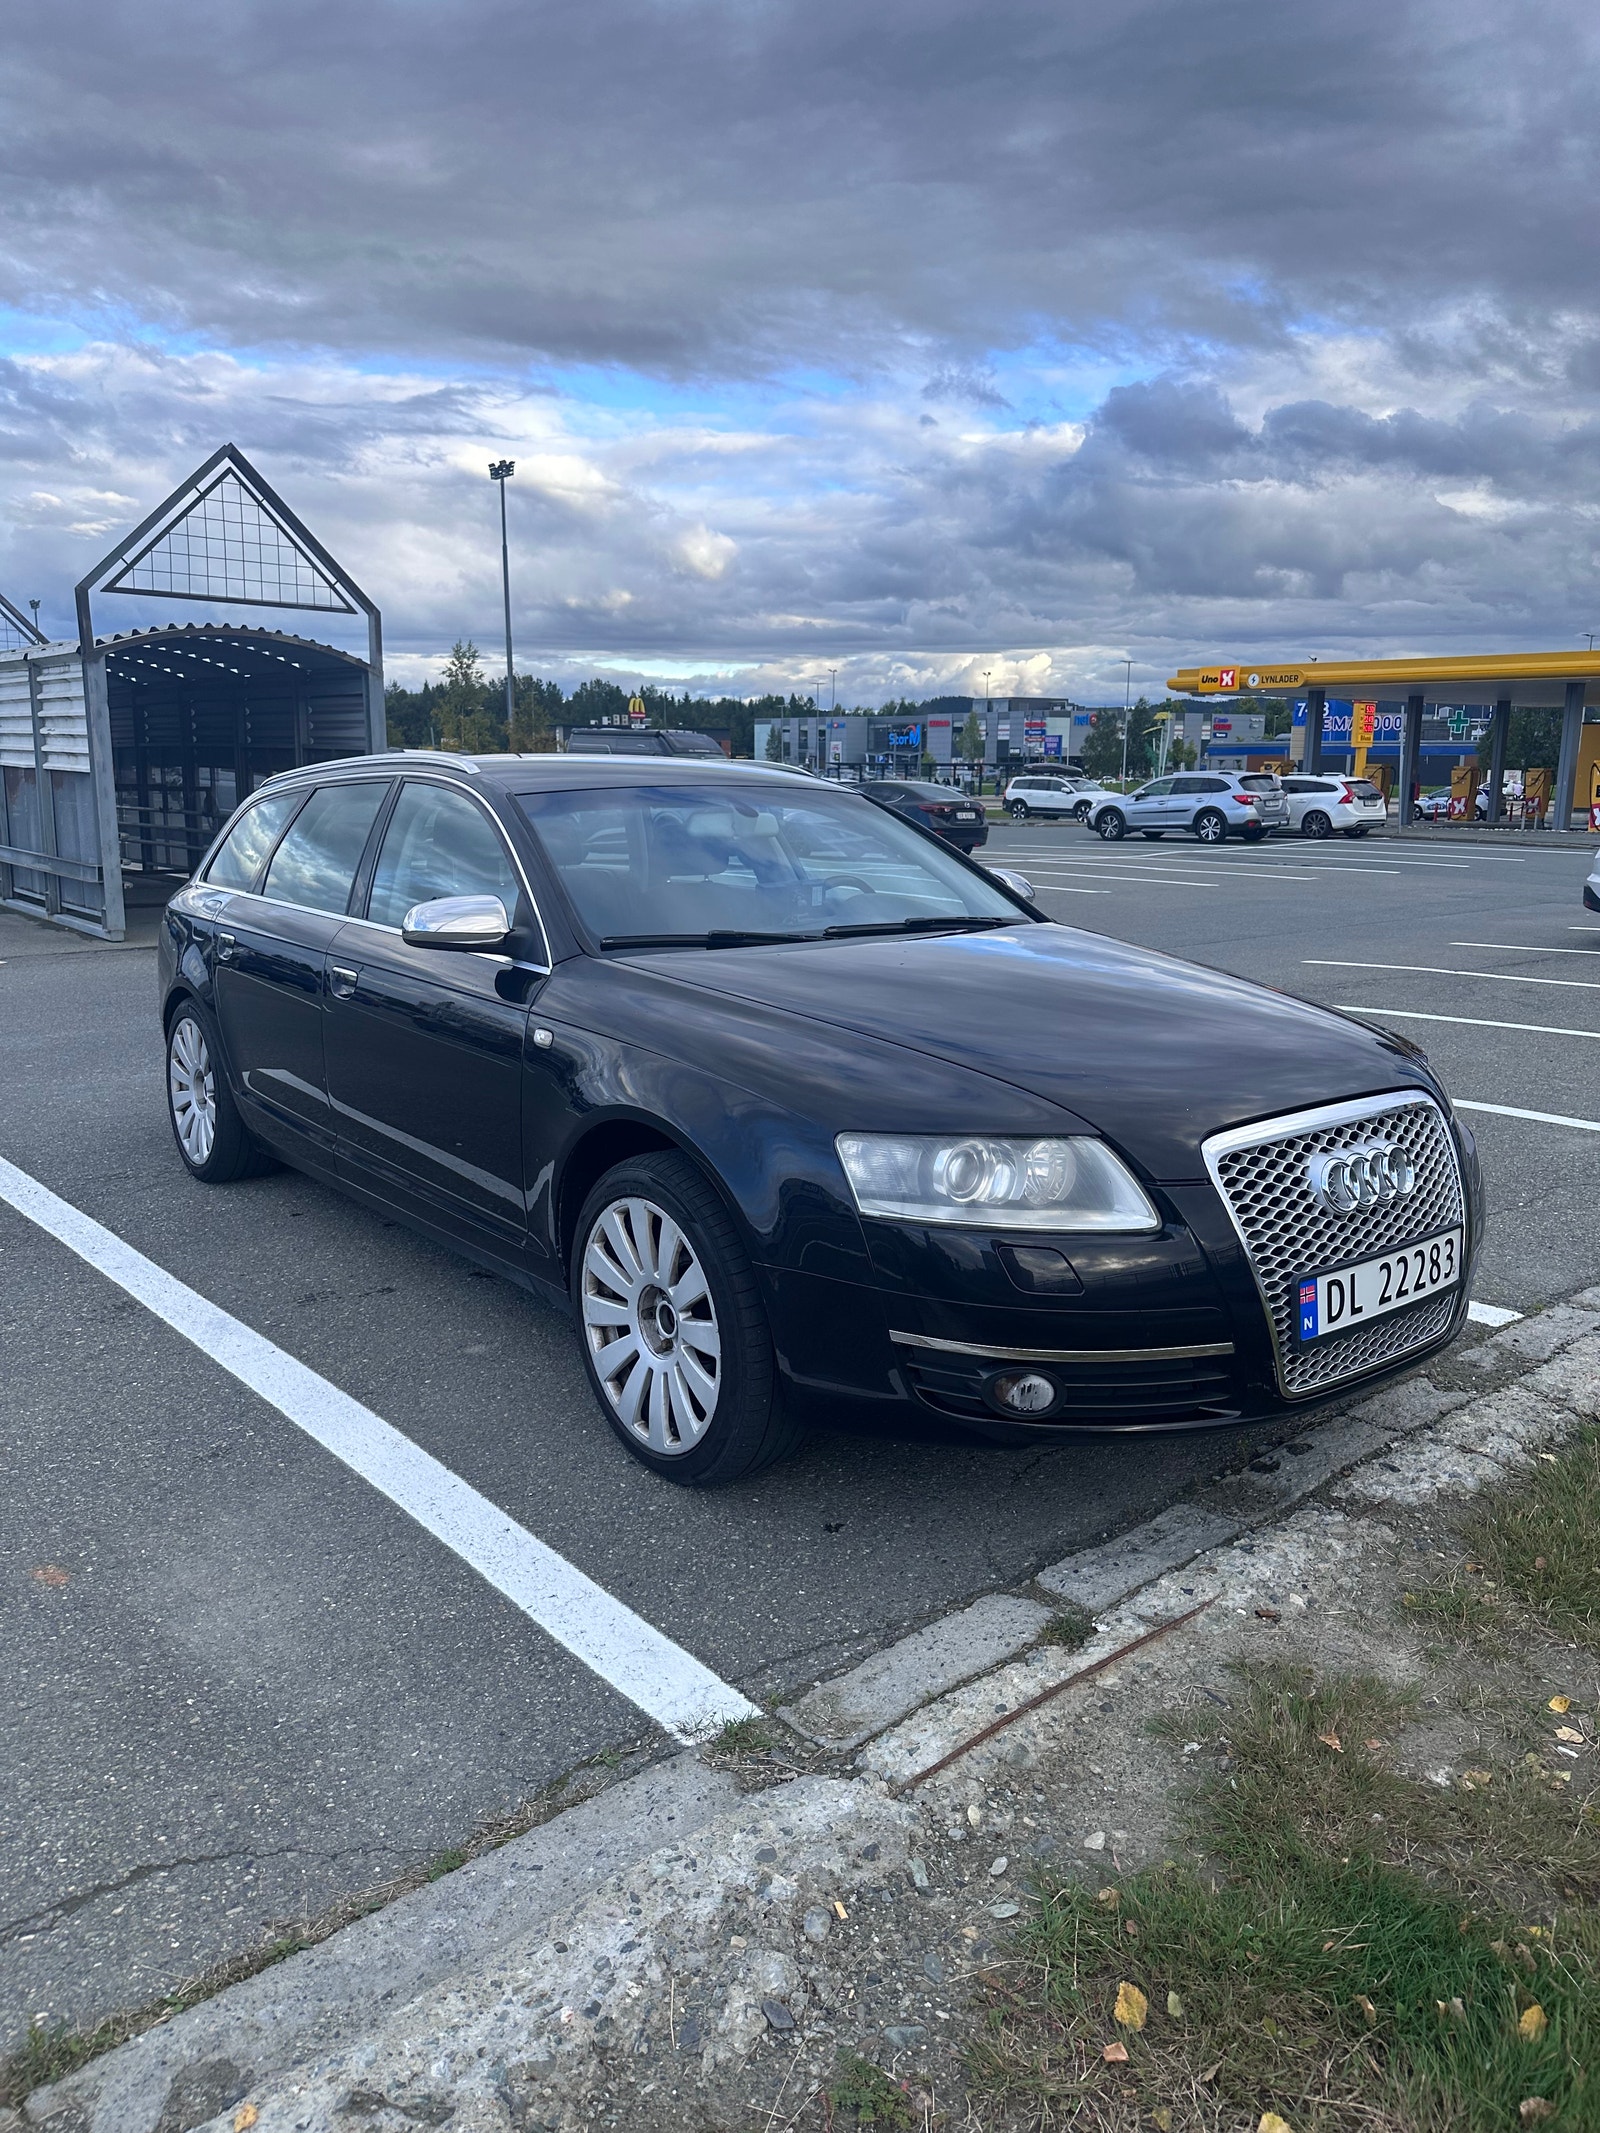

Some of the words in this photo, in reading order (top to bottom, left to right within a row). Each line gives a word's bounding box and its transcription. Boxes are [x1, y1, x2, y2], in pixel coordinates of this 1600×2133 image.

[1202, 675, 1219, 684] Uno
[1221, 670, 1235, 686] X
[1261, 674, 1299, 684] LYNLADER
[1327, 1273, 1363, 1324] DL
[1378, 1237, 1455, 1307] 22283
[1303, 1316, 1313, 1331] N
